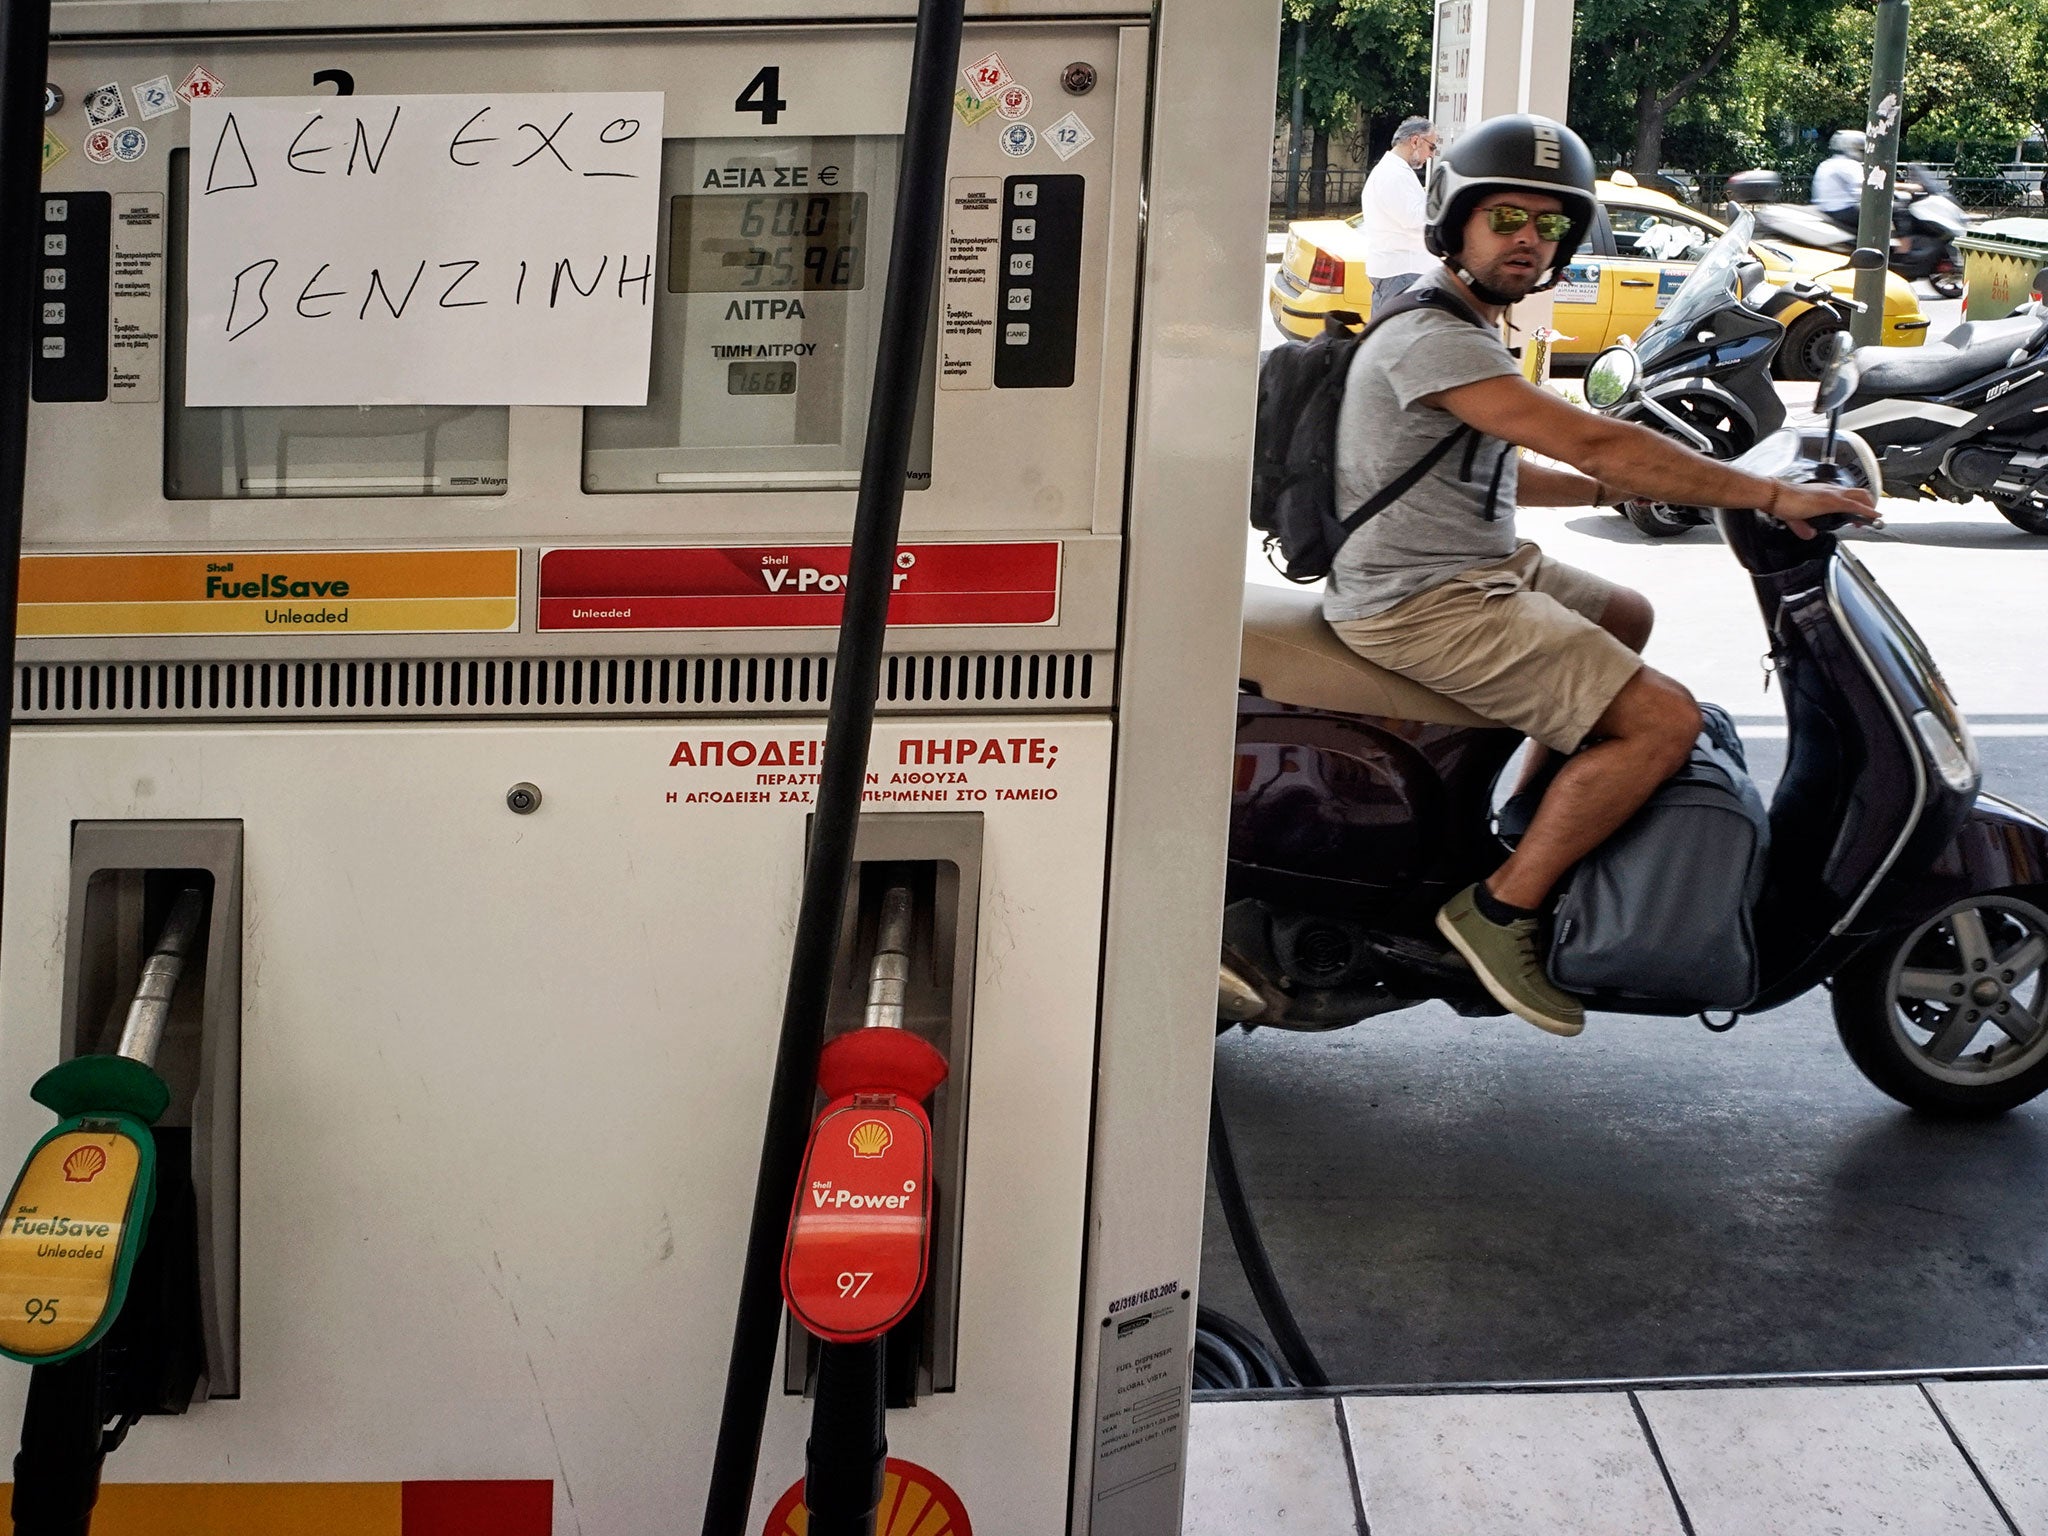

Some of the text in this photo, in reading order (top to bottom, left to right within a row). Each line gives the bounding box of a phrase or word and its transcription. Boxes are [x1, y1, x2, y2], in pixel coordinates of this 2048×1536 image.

[978, 67, 1000, 85] 14
[146, 89, 165, 106] 12
[190, 81, 212, 98] 14
[735, 66, 787, 125] 4
[1058, 128, 1077, 143] 12
[204, 105, 401, 196] ΔΕΝ
[702, 165, 840, 189] ΑΞΙΑ ΣΕ €
[740, 197, 861, 237] 60.01
[226, 254, 653, 342] ΒΕΝΖΙΝΗ
[724, 299, 806, 321] ΛΙΤΡΑ
[711, 343, 817, 358] ΤΙΜΗ ΛΙΤΡΟΥ
[206, 563, 234, 572] Shell
[761, 555, 789, 565] Shell
[206, 574, 350, 599] FuelSave
[761, 568, 908, 592] V-Por
[265, 607, 348, 624] Unleaded
[572, 608, 631, 618] Unleaded
[899, 738, 1059, 769] ΠΗΡΑΤΕ;
[890, 772, 968, 784] ΑΙΘΟΥΣΑ
[666, 788, 1058, 805] Η ΑΠΟΔΕΙΞΗ ΣΑΣ, ΠΕΡΙΜΕΝΕΙ ΣΤΟ ΤΑΜΕΙΟ
[812, 1181, 832, 1190] Shell
[812, 1189, 910, 1209] V-Power
[18, 1205, 38, 1215] Shell
[11, 1215, 110, 1238] FuelSave
[37, 1243, 105, 1259] Unleaded
[836, 1271, 874, 1299] 97
[25, 1298, 59, 1325] 95
